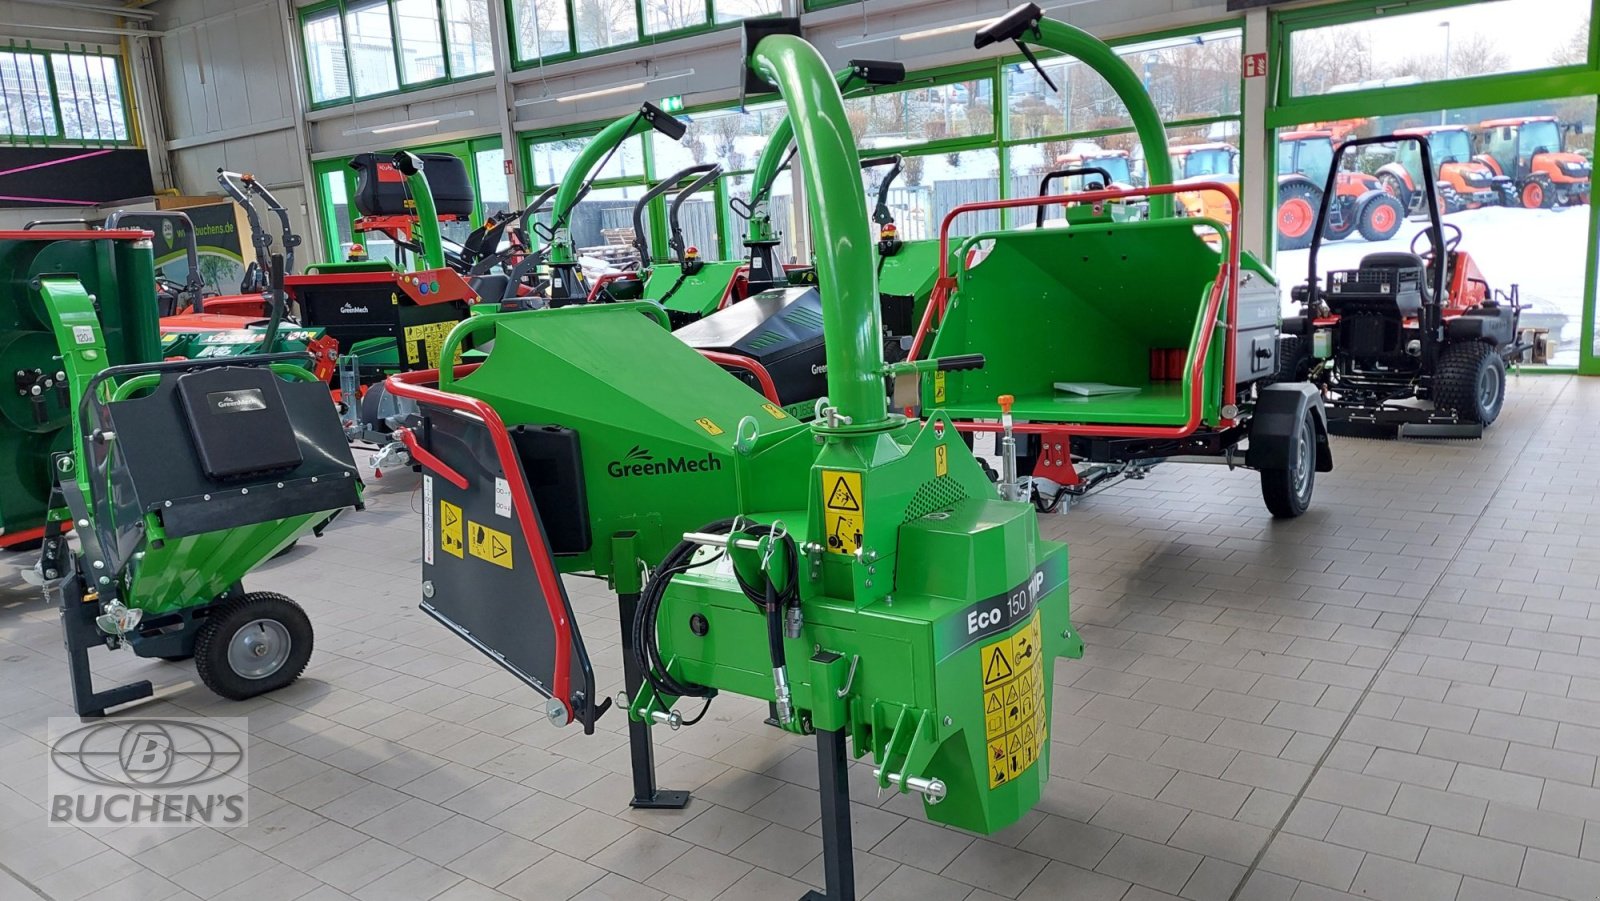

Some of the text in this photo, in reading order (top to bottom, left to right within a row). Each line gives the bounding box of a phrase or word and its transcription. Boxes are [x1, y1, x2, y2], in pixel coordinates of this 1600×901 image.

[607, 452, 721, 478] GreenMech
[967, 608, 1001, 635] Eco
[1007, 590, 1027, 618] 150
